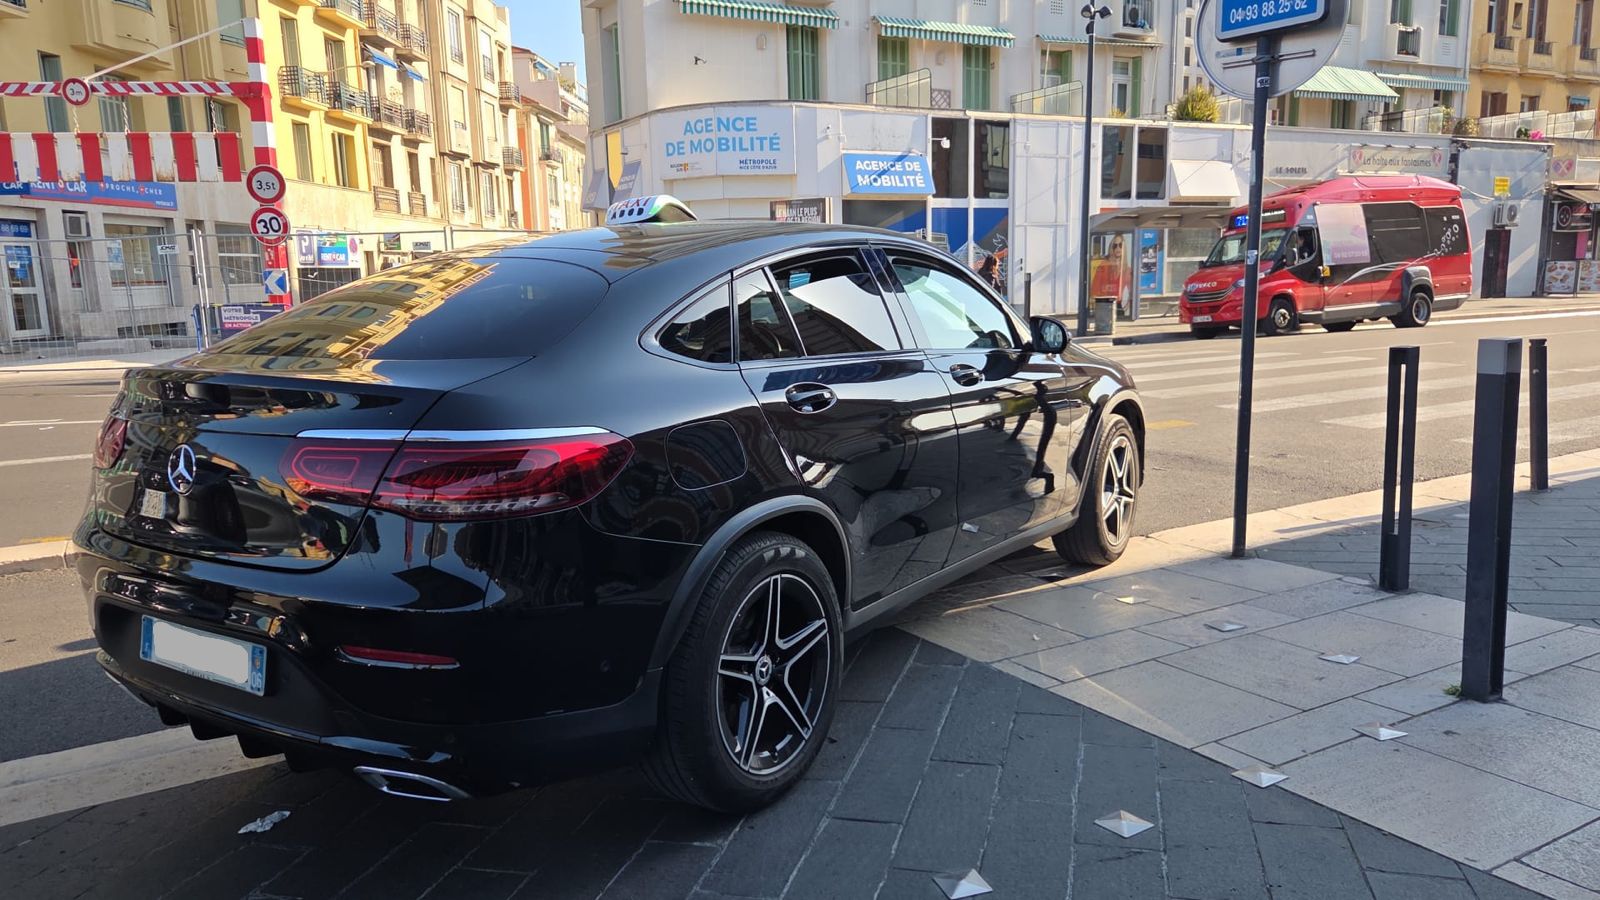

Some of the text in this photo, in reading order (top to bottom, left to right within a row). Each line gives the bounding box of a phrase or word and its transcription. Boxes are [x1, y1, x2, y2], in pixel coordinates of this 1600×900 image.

[1229, 7, 1243, 25] 04
[1245, 4, 1259, 21] 93
[1261, 0, 1275, 18] 88
[1278, 0, 1291, 14] 25
[683, 116, 758, 136] AGENCE
[665, 132, 781, 158] DE MOBILITÉ
[739, 158, 777, 166] MÉTROPOLE
[855, 160, 922, 172] AGENCE DE
[857, 172, 926, 188] MOBILITÉ
[610, 196, 652, 210] TAXI
[257, 216, 282, 235] 30
[251, 671, 263, 689] 06
